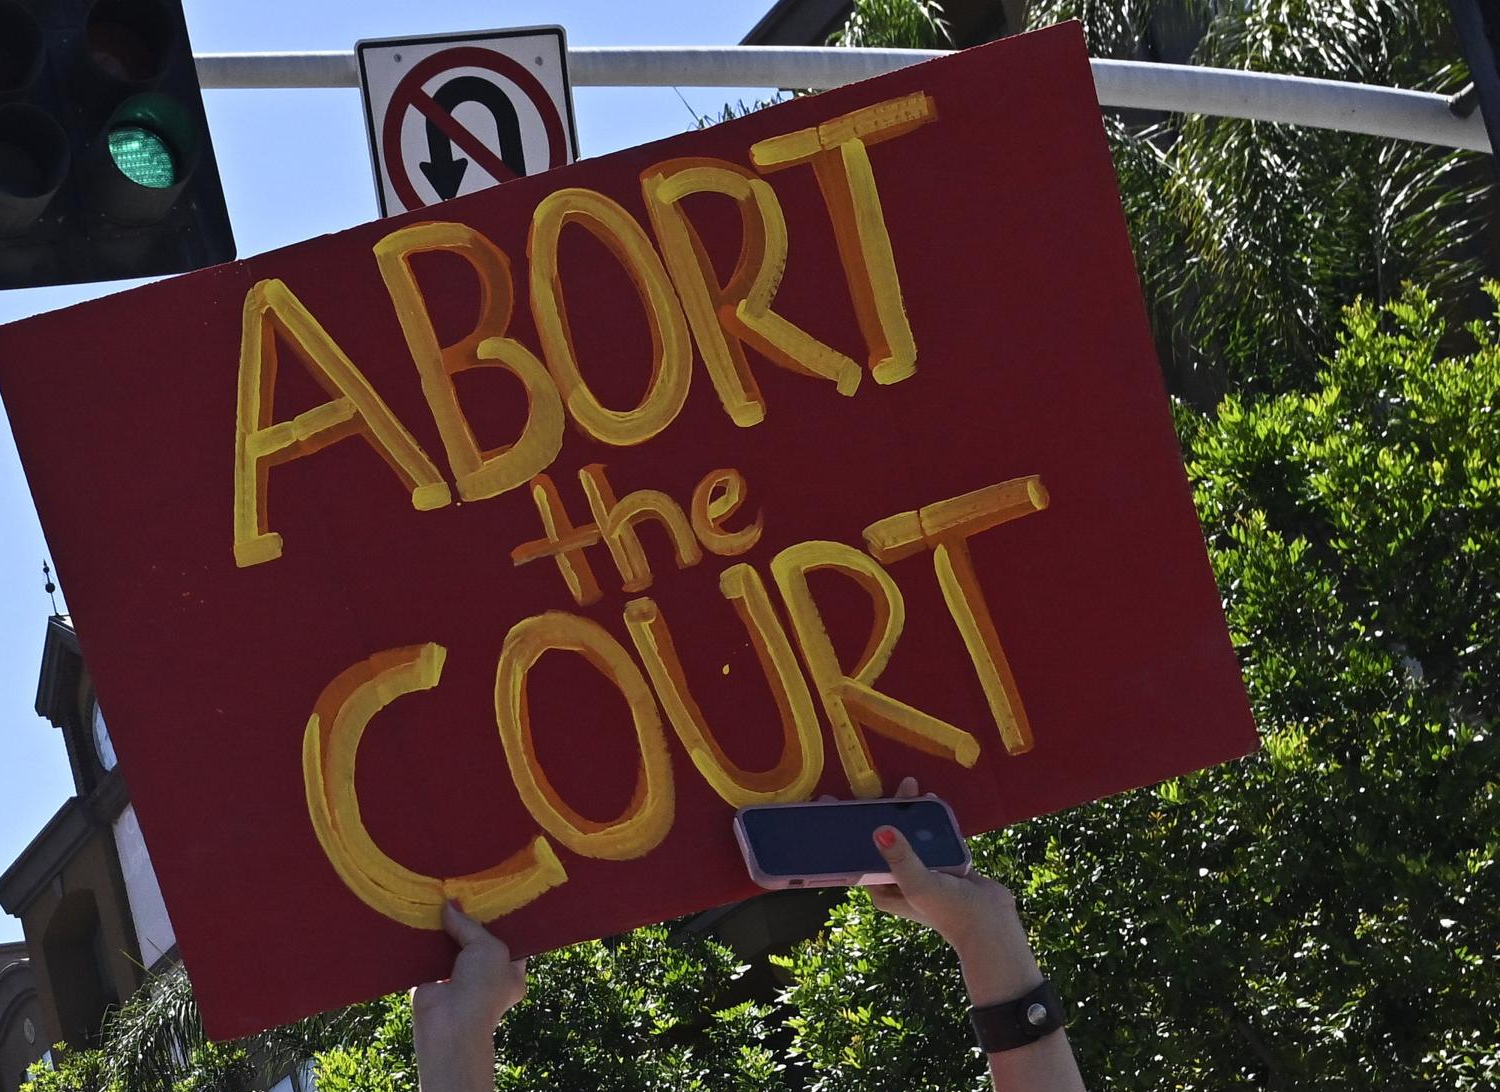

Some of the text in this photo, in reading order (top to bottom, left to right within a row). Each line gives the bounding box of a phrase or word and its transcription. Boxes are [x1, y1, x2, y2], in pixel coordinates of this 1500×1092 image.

[234, 91, 940, 568] ABORT
[510, 463, 764, 605] the
[303, 474, 1050, 931] COURT
